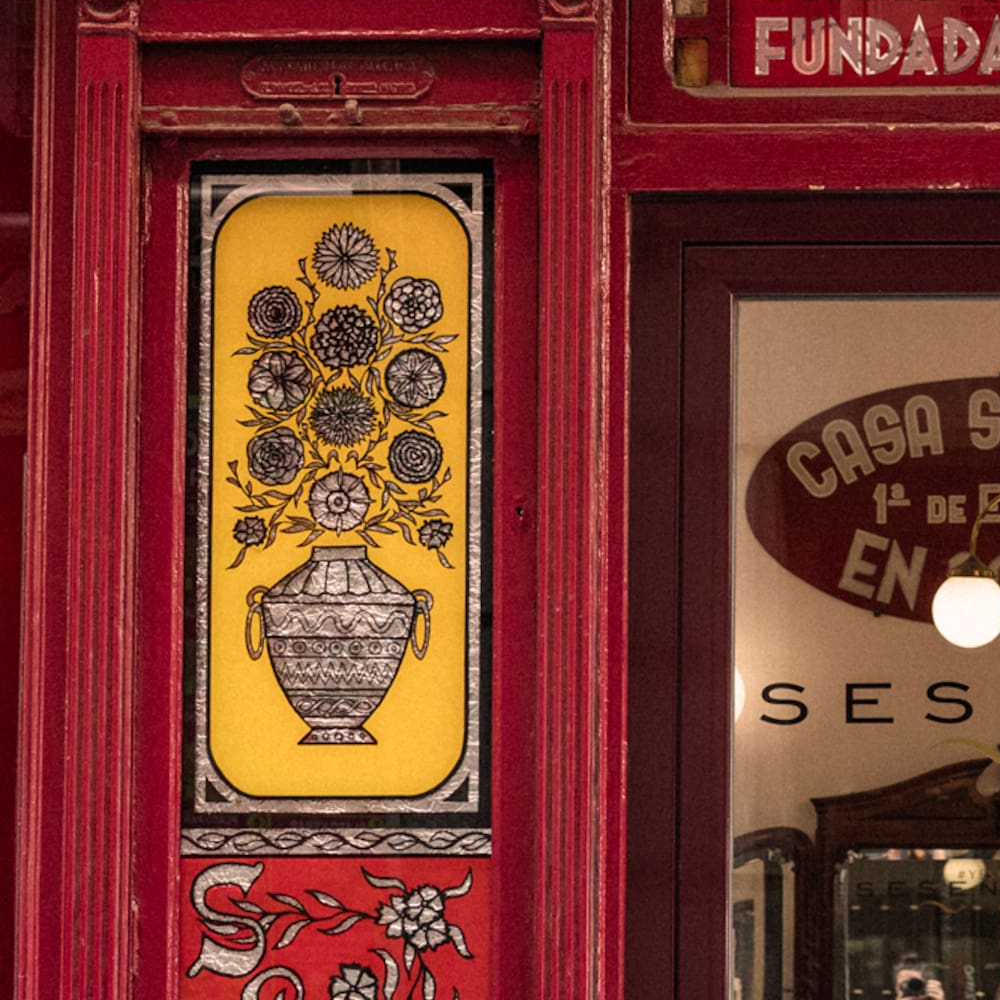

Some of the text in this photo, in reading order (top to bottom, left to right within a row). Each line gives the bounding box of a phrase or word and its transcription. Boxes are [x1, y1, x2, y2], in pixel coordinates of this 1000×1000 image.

[786, 393, 944, 499] CASA
[926, 494, 967, 525] DE
[838, 528, 928, 613] EN
